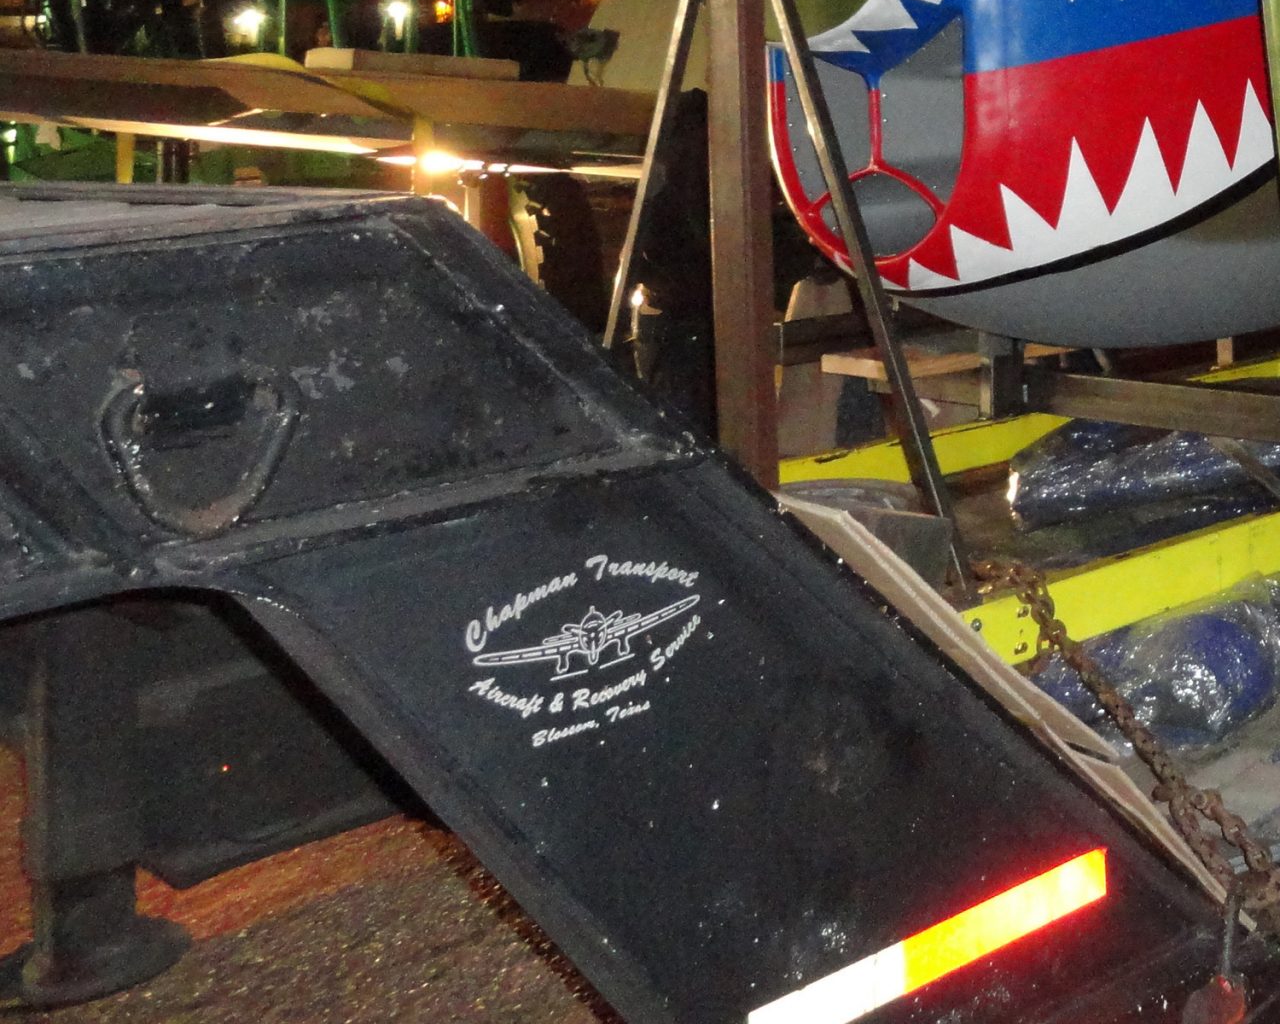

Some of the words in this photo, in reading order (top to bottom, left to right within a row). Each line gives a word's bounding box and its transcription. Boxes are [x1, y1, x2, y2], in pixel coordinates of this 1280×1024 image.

[465, 572, 578, 652] Chapman
[586, 554, 699, 587] Transport
[468, 677, 544, 718] Aircraft
[549, 692, 564, 713] &
[572, 669, 647, 710] Recovery
[650, 614, 701, 671] Service
[605, 700, 650, 723] Texas
